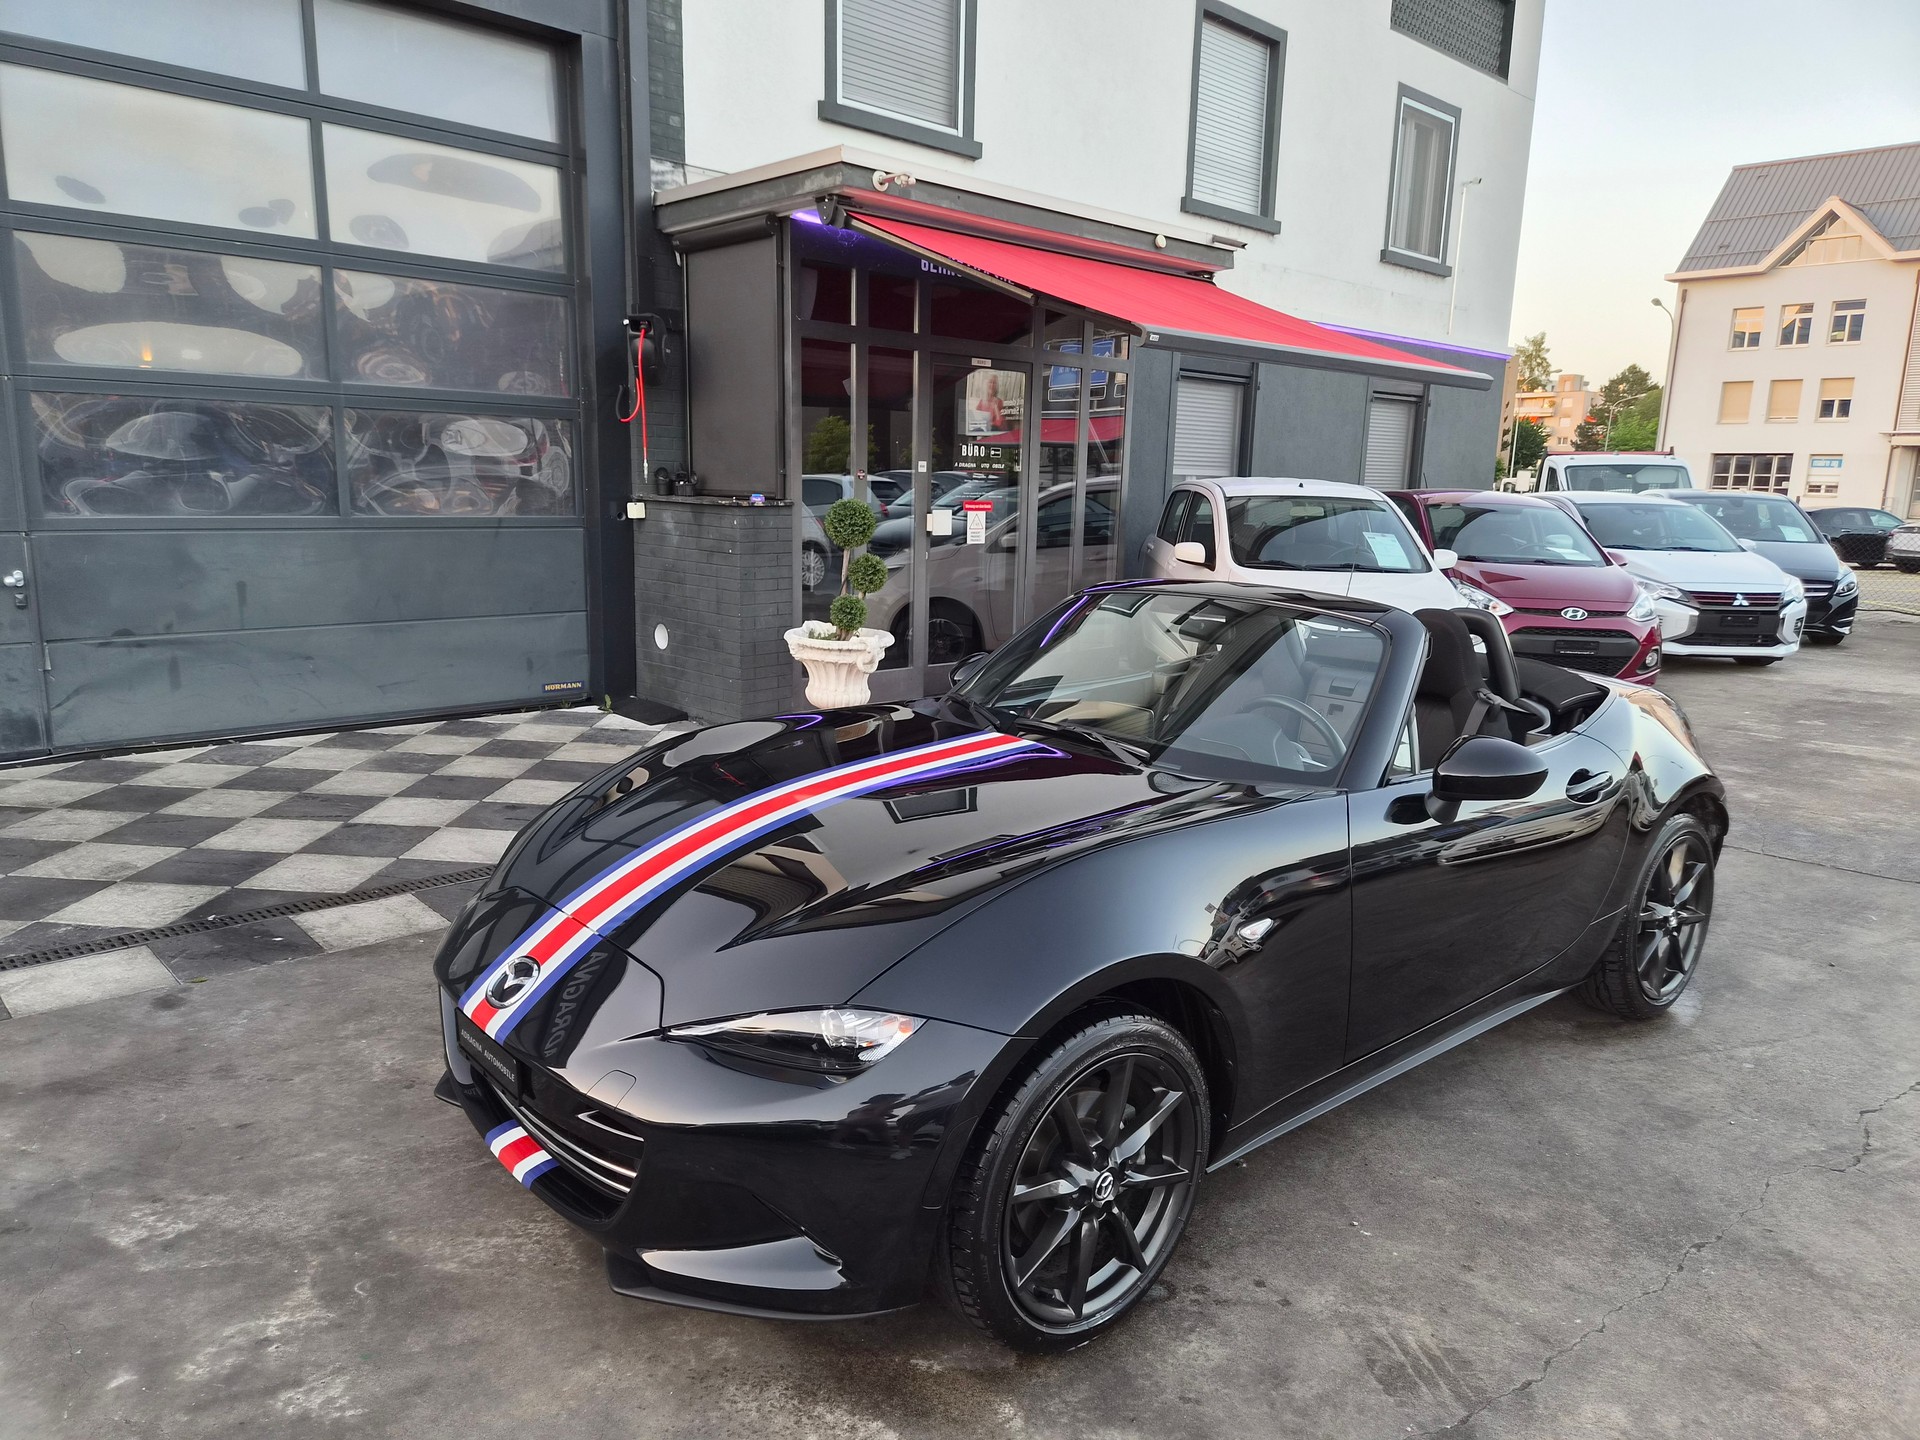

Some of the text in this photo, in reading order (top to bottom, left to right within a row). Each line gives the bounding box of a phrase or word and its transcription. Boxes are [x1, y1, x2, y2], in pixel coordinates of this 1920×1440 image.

[961, 443, 985, 457] BÜRO
[461, 1029, 515, 1083] ADRAGNA AUTOMOBILE
